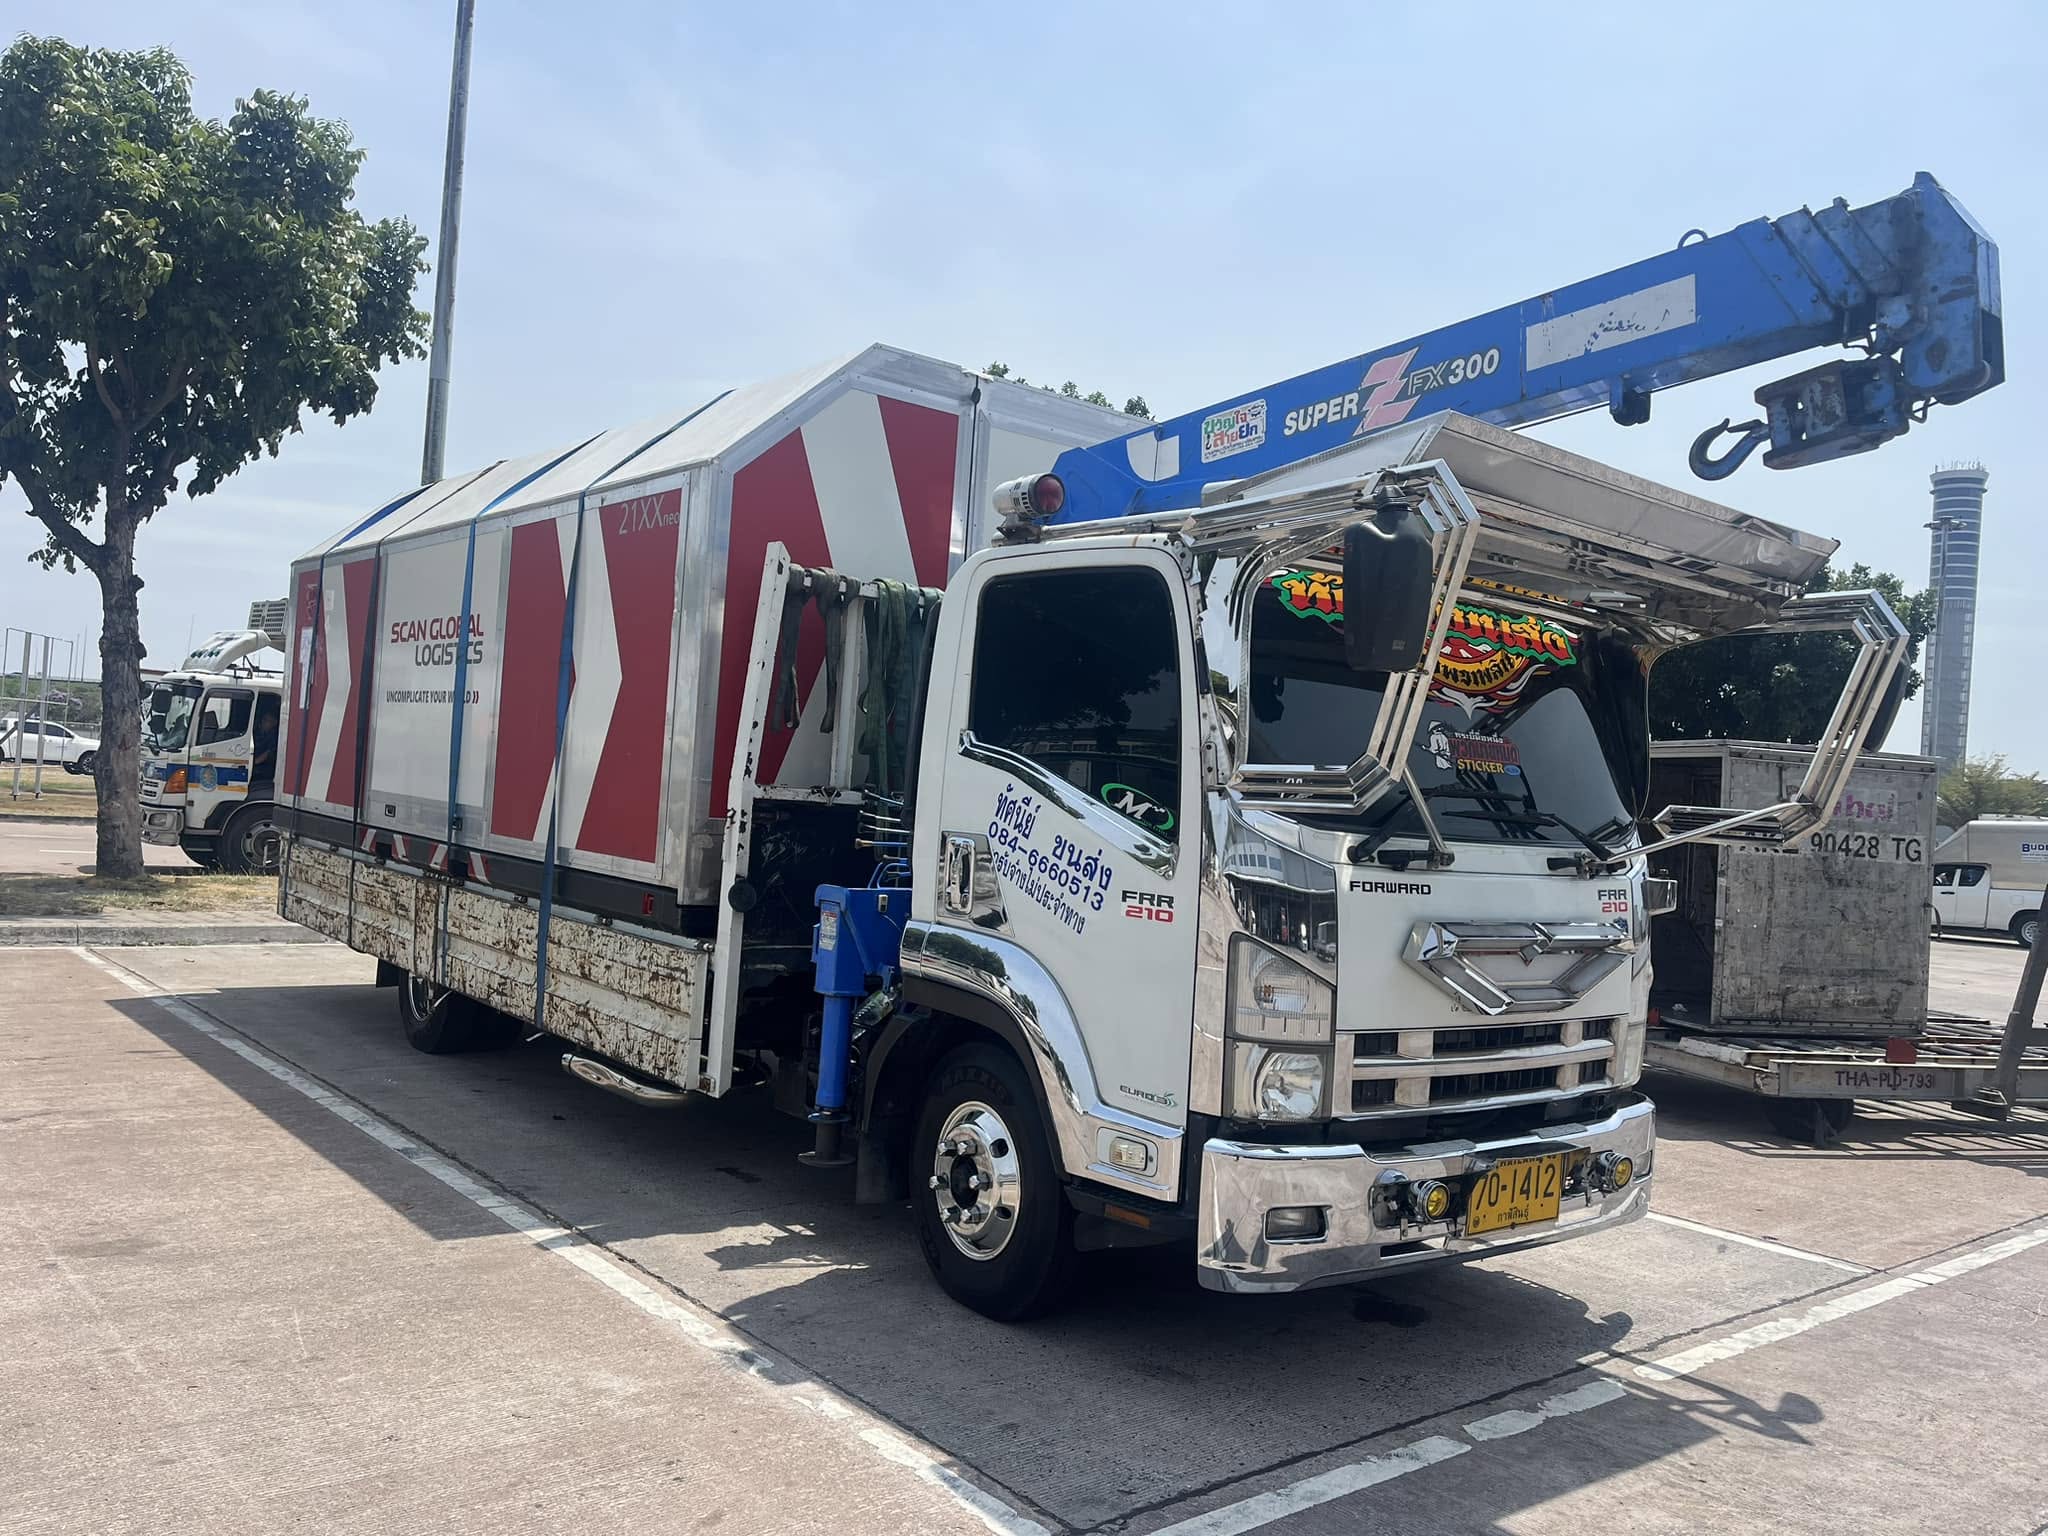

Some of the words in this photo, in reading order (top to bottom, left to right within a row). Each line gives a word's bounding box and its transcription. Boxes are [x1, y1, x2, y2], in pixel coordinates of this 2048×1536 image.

[1283, 392, 1360, 436] SUPER
[391, 619, 428, 644] SCAN
[415, 640, 483, 667] LOGISCS
[386, 689, 430, 704] UNCOMPLICATE
[430, 690, 447, 704] YOUR
[1457, 758, 1505, 774] STICKER
[1811, 832, 1879, 860] 90428
[1892, 836, 1922, 863] TG
[988, 821, 1105, 912] 084-6660513
[1051, 834, 1113, 892] ขนส่ง
[1350, 881, 1431, 896] FORWARD
[1598, 889, 1627, 901] FRR
[1121, 890, 1175, 910] FRR
[1602, 902, 1628, 913] 210
[1125, 905, 1174, 923] 210
[1476, 1163, 1556, 1211] 70-1412
